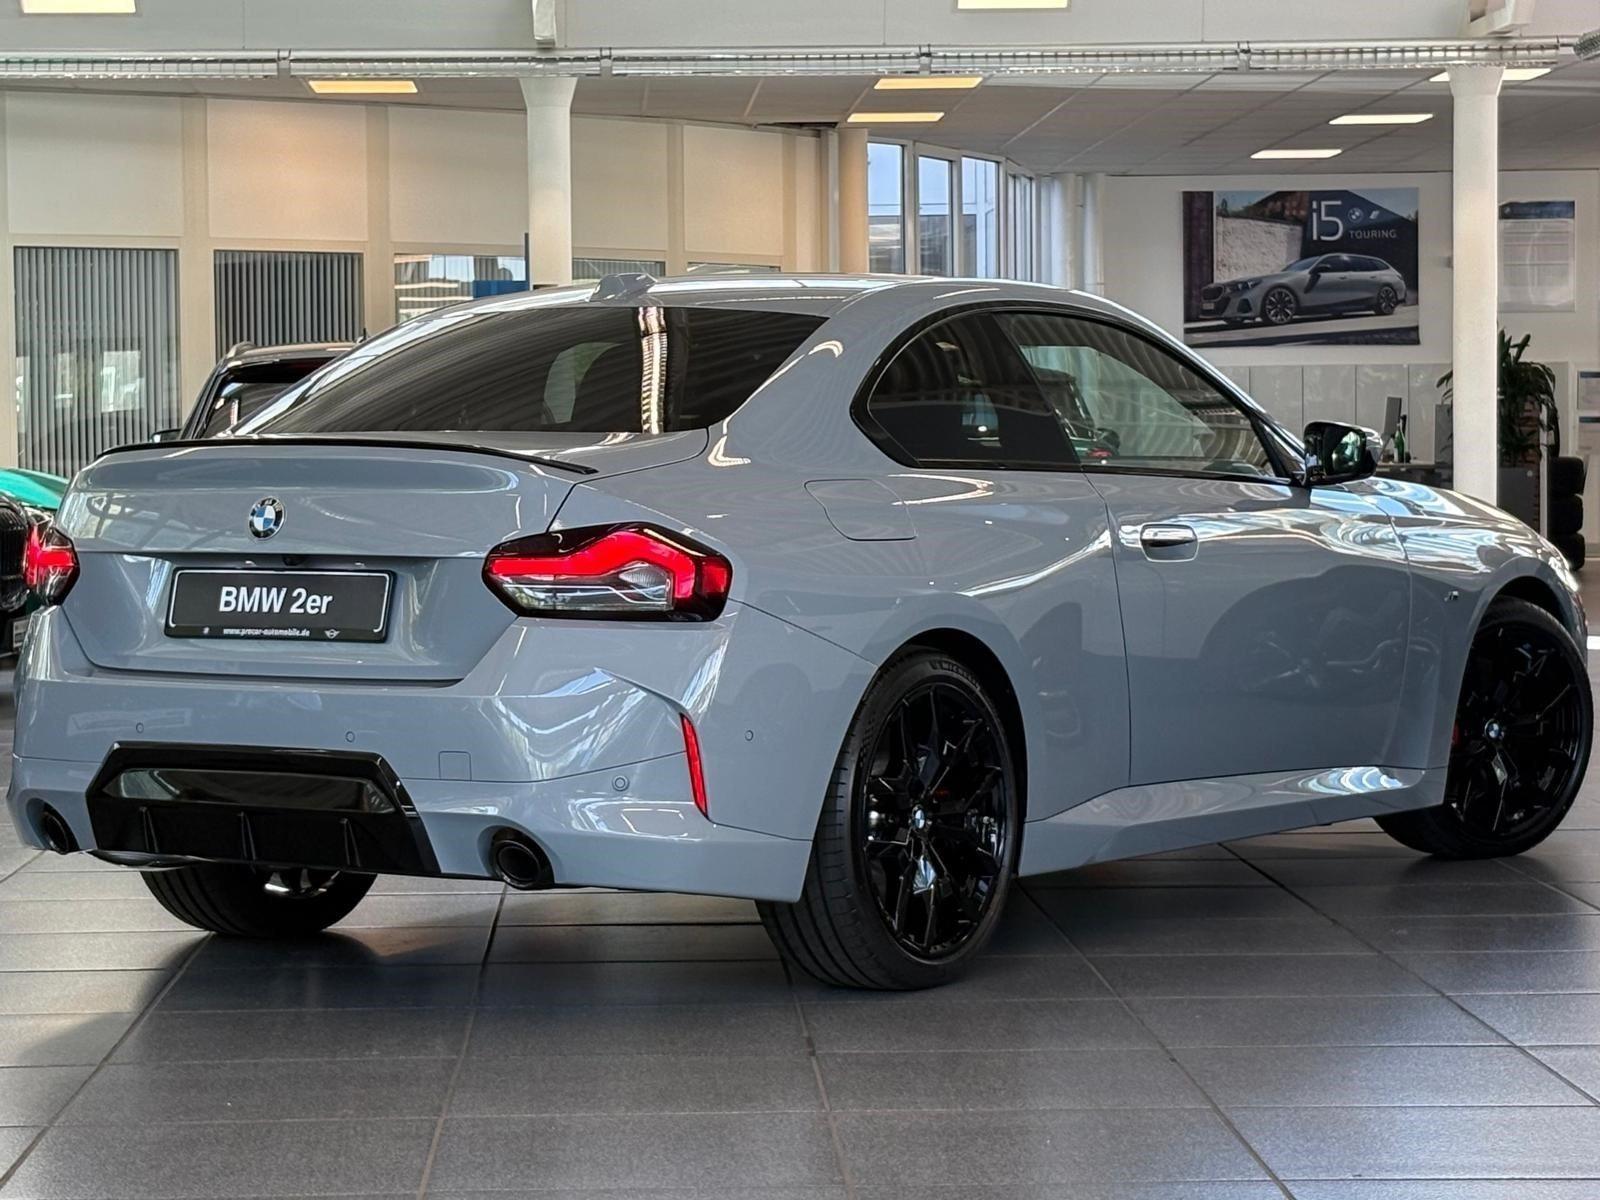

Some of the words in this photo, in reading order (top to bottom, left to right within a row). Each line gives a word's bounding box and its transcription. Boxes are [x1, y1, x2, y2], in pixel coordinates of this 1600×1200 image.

[1312, 200, 1344, 241] i5
[1350, 230, 1397, 240] TOURING
[219, 586, 287, 613] BMW
[290, 588, 333, 614] 2er
